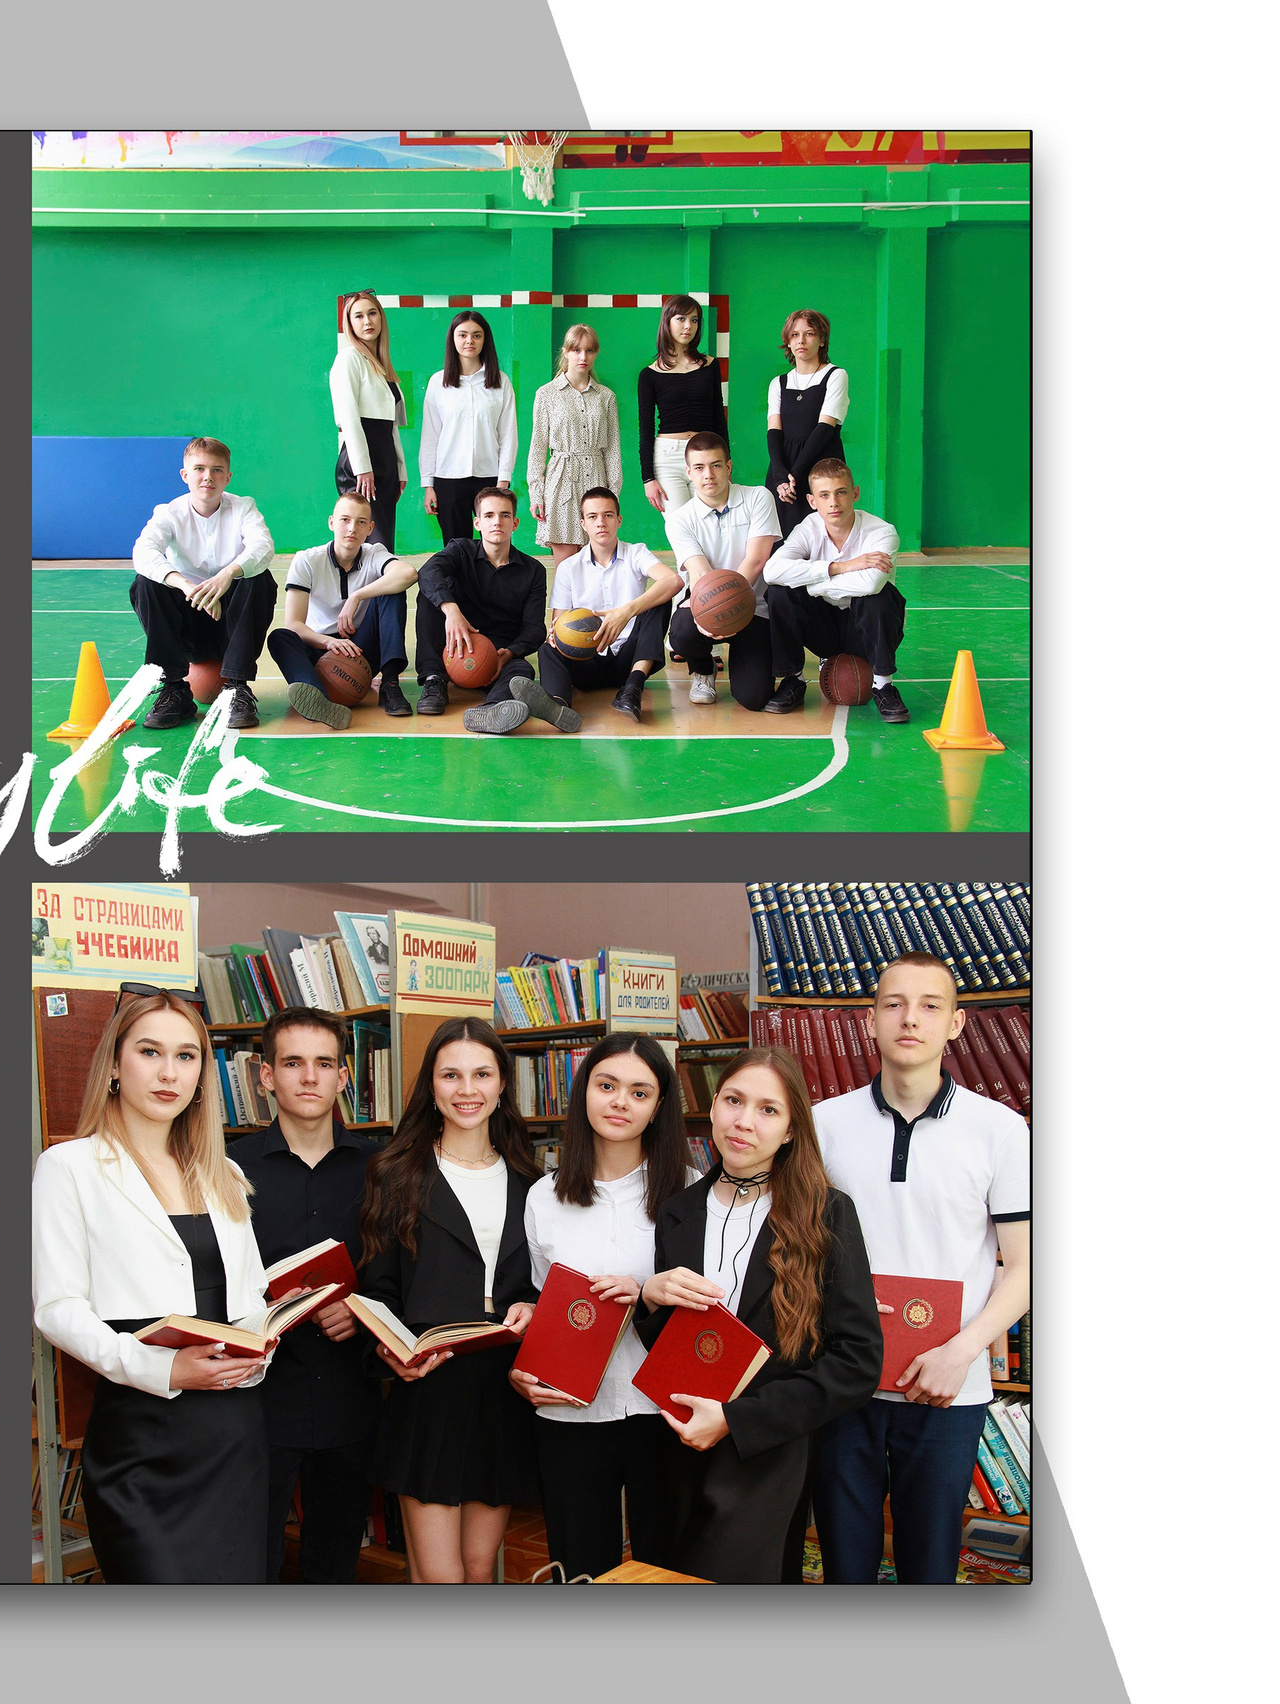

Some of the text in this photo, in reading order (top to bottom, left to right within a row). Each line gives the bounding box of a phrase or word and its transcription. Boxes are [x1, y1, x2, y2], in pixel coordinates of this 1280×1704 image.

[699, 579, 741, 606] SPALDING
[331, 665, 364, 693] SPALDING
[37, 888, 184, 931] ЗА СТРАНИЦАМИ
[303, 972, 319, 1008] Горький
[425, 965, 490, 994] ЗООПАРК
[618, 995, 669, 1010] ДЛЯ РОДИТЕЛЕЙ
[232, 1075, 246, 1121] Островский
[976, 1083, 984, 1092] 13
[994, 1081, 1002, 1090] 14
[1018, 1082, 1026, 1091] 14
